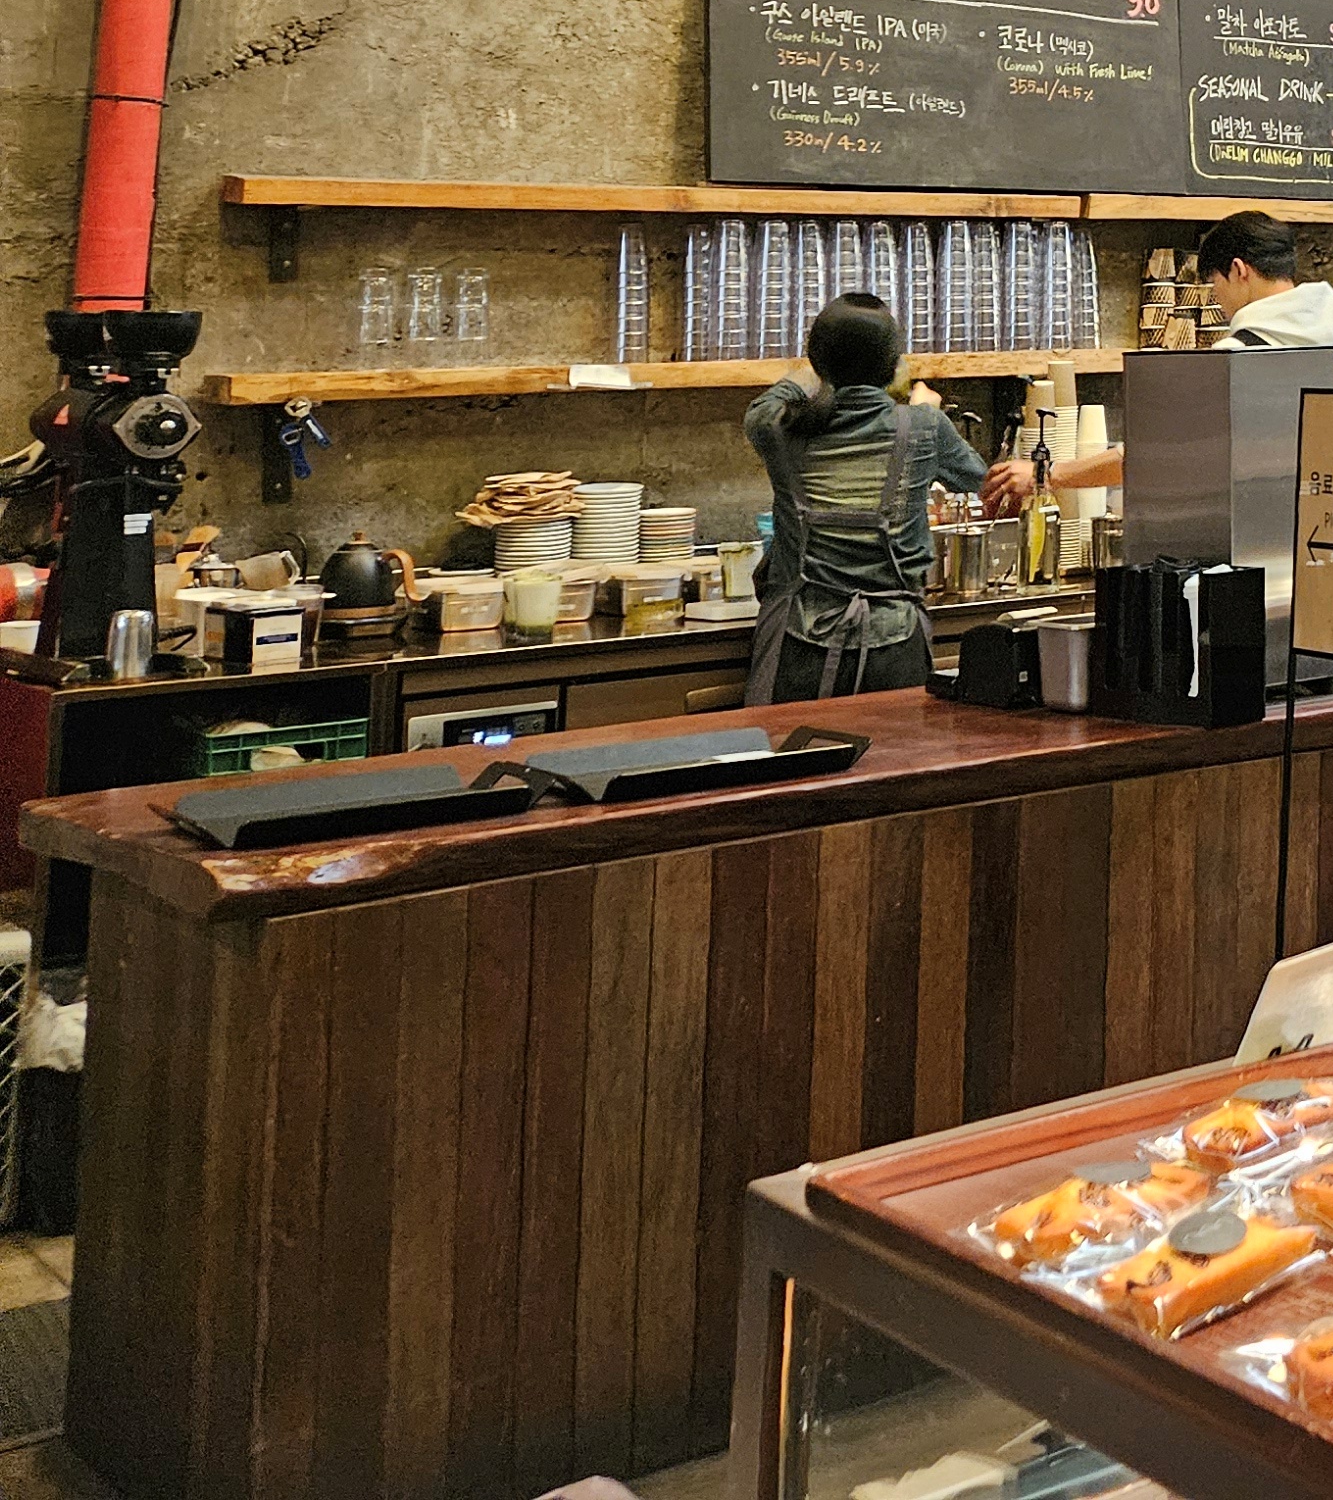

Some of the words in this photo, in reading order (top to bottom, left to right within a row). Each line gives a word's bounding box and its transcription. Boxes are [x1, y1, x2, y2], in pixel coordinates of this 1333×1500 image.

[761, 1, 792, 24] 구스
[801, 3, 867, 34] 아일랜드
[1218, 5, 1247, 35] 말차
[1254, 9, 1307, 39] 아포가토
[811, 31, 844, 47] Island
[855, 38, 882, 53] IPA)
[998, 25, 1043, 53] 코로나
[1223, 39, 1263, 57] (Matcha
[997, 55, 1044, 75] (Corona)
[767, 79, 820, 105] 기네스
[1198, 75, 1269, 102] SEASONAL
[1279, 78, 1324, 104] DRINK
[1253, 148, 1302, 167] CHANGGO
[1310, 472, 1333, 494] 음료
